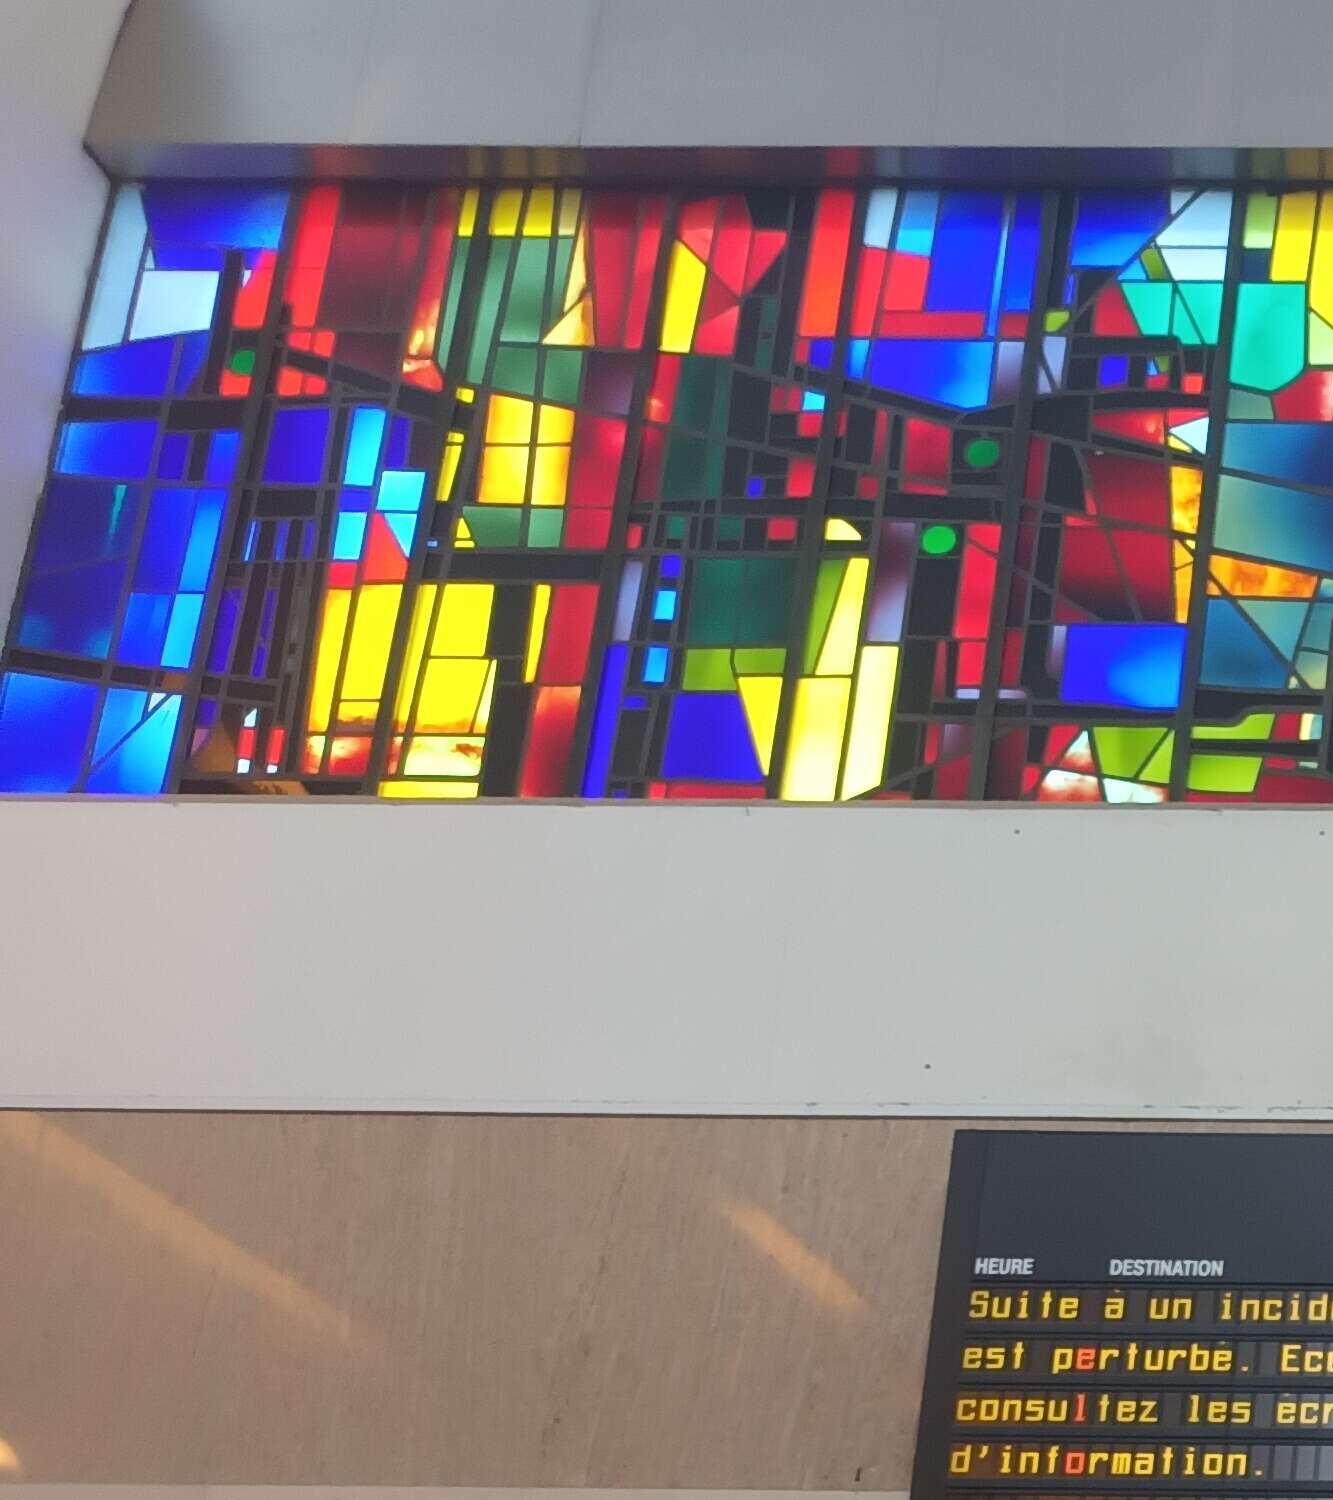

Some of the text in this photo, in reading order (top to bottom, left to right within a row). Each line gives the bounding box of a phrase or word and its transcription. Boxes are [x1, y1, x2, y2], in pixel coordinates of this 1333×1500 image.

[974, 1258, 1034, 1275] HEURE
[1109, 1259, 1224, 1277] DESTINATION
[968, 1290, 1080, 1320] Suite
[1150, 1296, 1192, 1321] un
[962, 1344, 1025, 1371] est
[956, 1395, 1158, 1425] consultez
[1189, 1395, 1251, 1425] les
[950, 1444, 1264, 1477] d'information.
